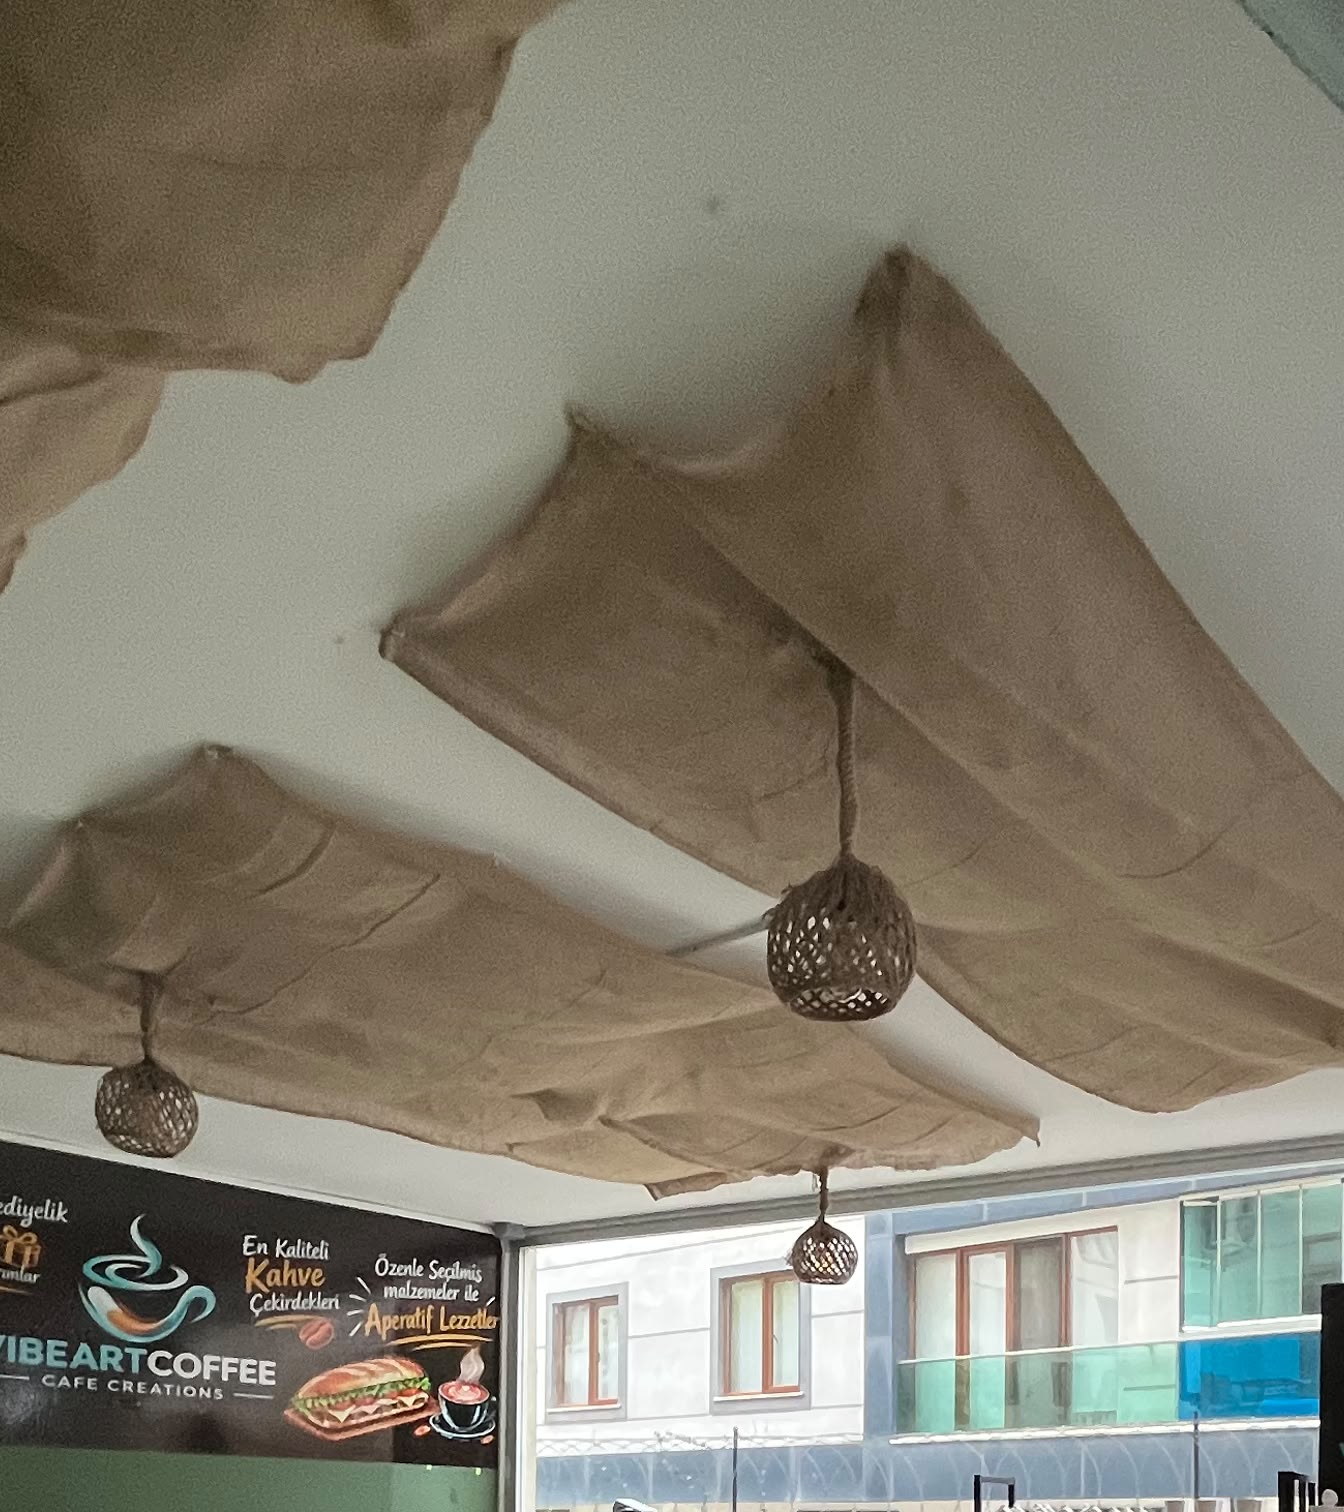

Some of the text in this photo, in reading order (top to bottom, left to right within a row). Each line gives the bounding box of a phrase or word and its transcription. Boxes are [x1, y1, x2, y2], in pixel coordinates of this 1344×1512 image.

[242, 1234, 329, 1260] En Kaliteli
[245, 1257, 326, 1293] Kahve
[375, 1253, 424, 1277] Özenle
[383, 1280, 480, 1301] malzemeler ile
[249, 1290, 340, 1318] Çekirdekleri
[364, 1303, 498, 1340] Aperatif Lezzetler
[41, 1374, 224, 1400] CAFE CREATIONS
